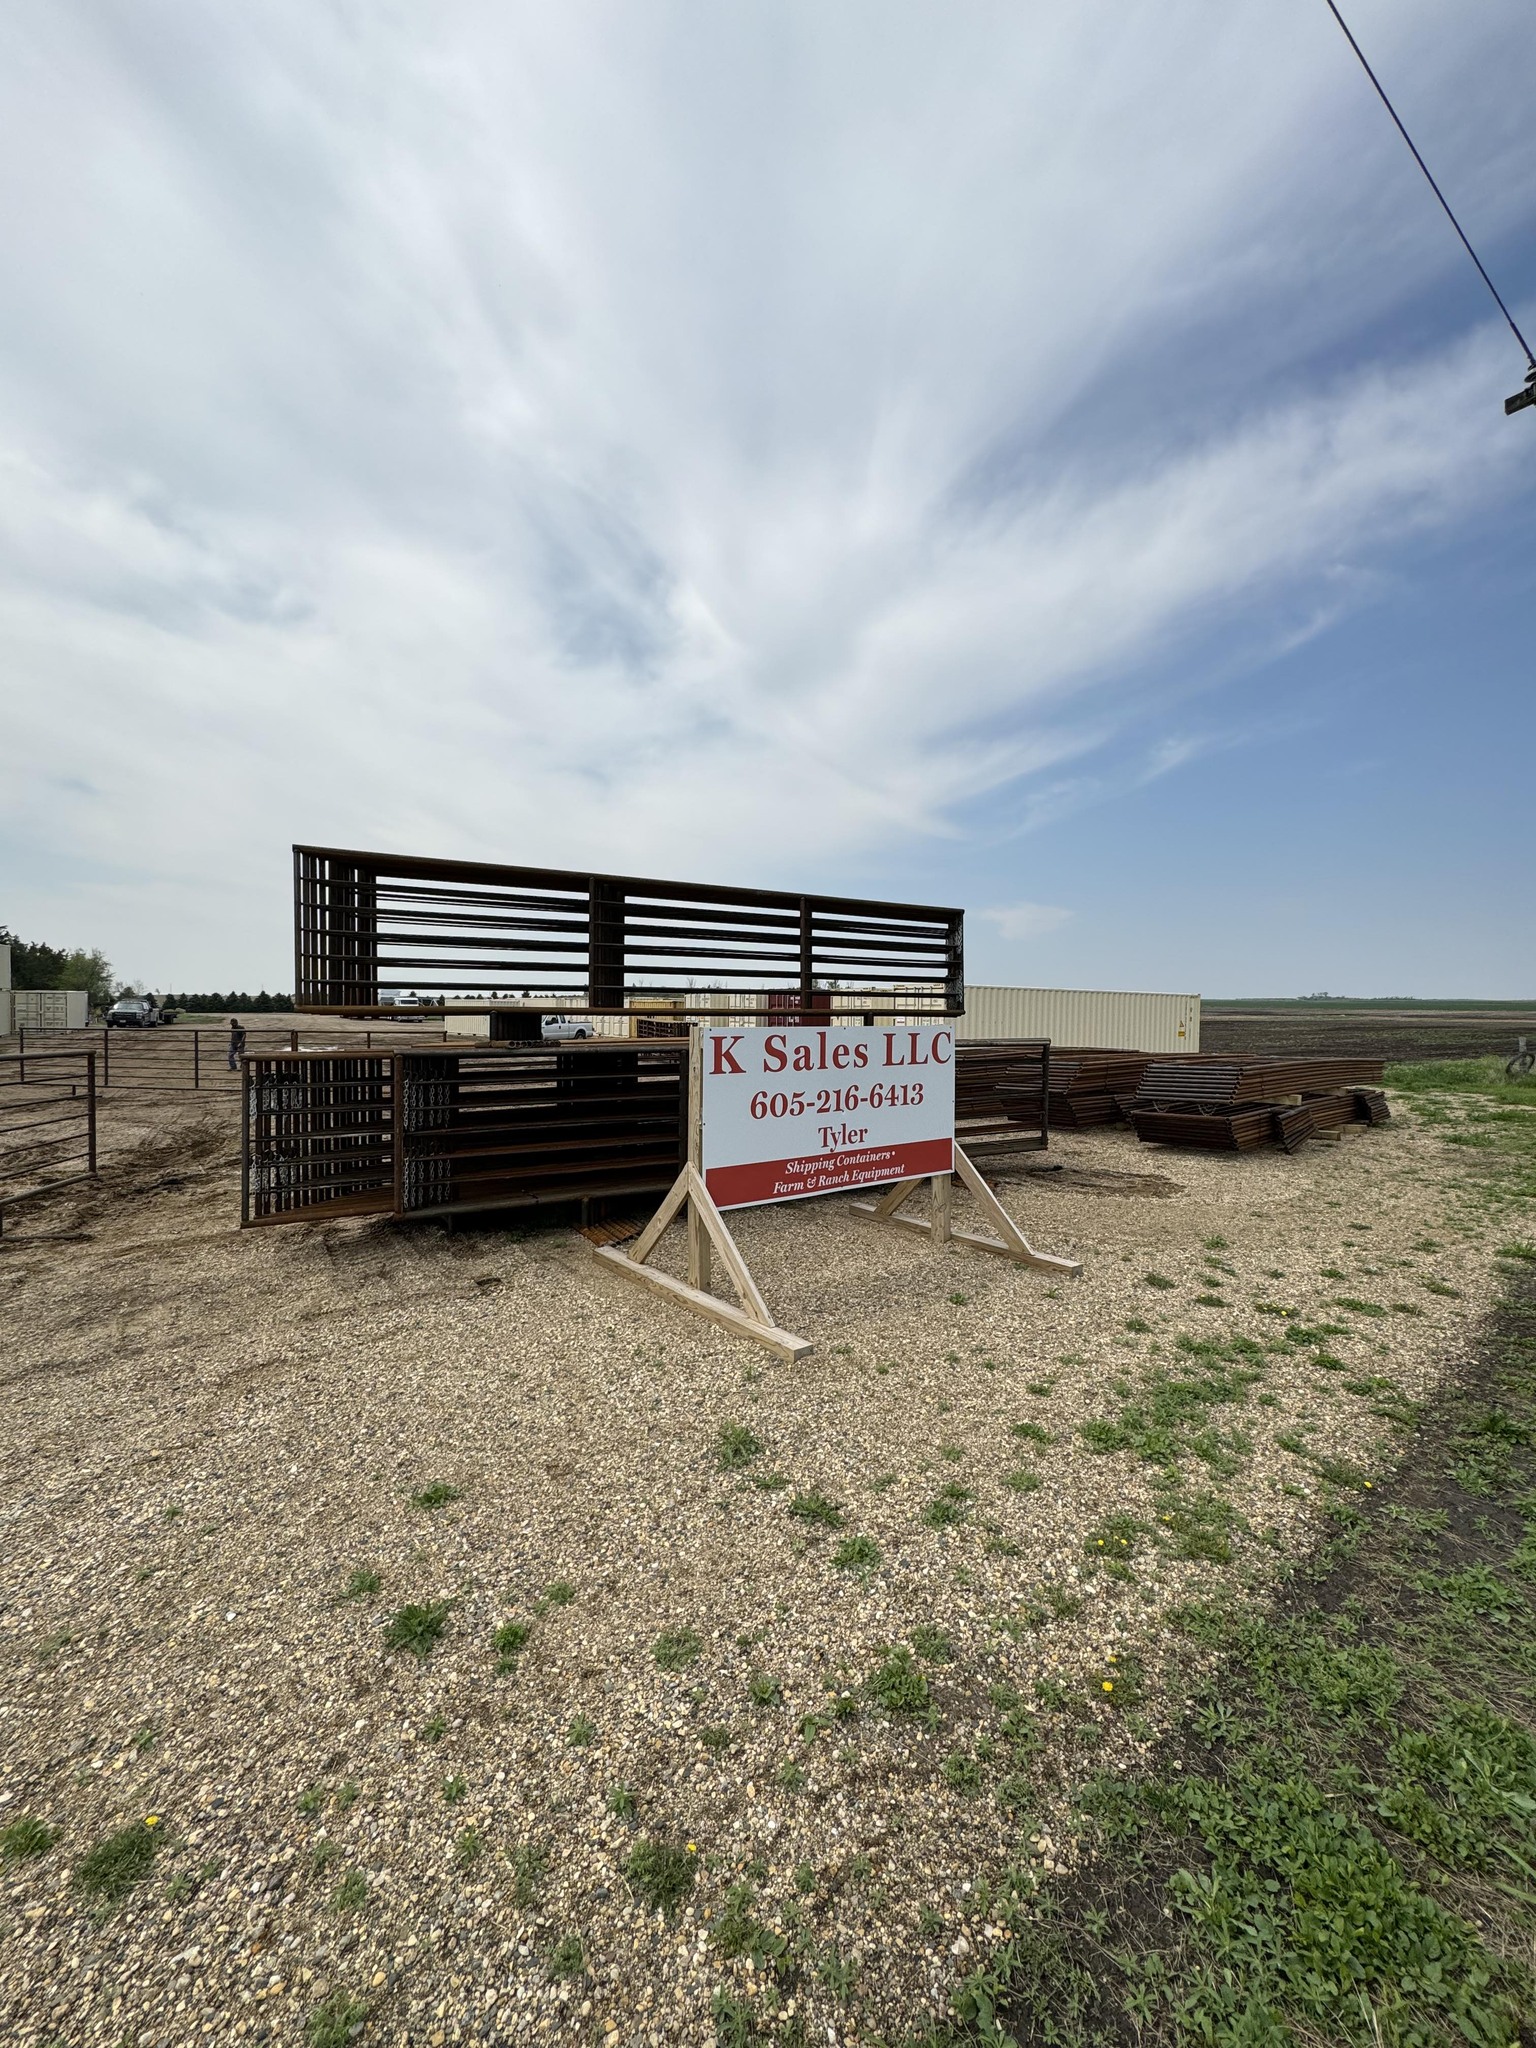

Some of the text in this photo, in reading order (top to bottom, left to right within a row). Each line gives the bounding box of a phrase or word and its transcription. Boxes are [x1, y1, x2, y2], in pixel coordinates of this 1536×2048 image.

[709, 1031, 952, 1075] K Sales LLC
[750, 1083, 924, 1119] 605-216-6413
[818, 1123, 868, 1153] Tyler
[785, 1151, 891, 1175] Shipping Containers
[773, 1164, 905, 1194] Farm & Ranch Equipment
